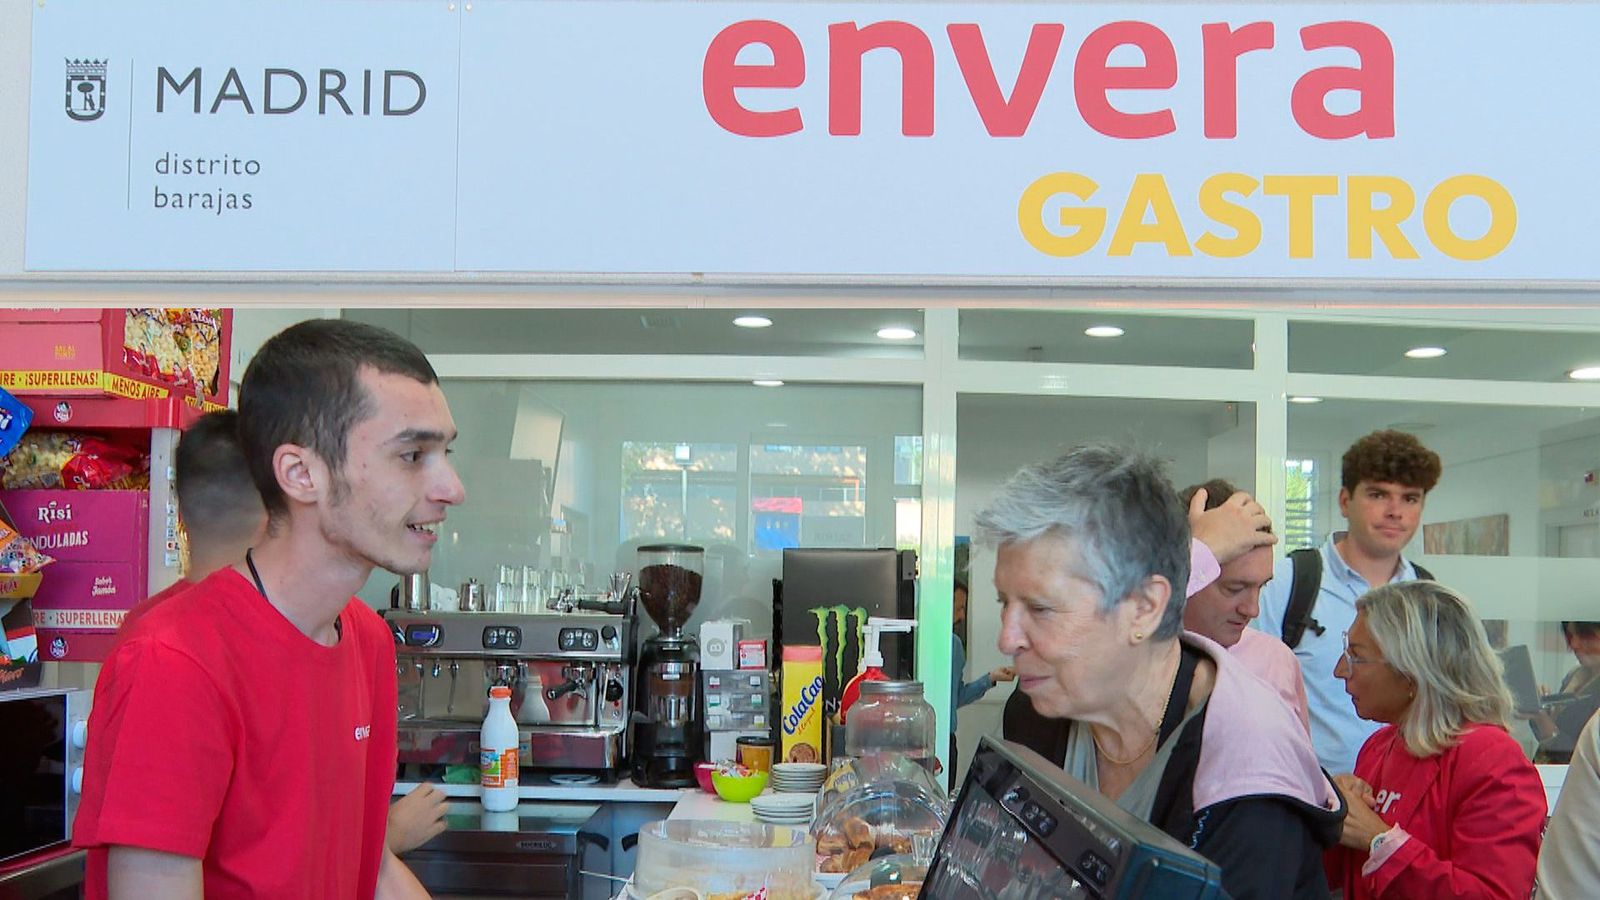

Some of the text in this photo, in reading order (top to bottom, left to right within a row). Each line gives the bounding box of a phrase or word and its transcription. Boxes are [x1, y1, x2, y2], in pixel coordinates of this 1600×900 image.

[156, 66, 426, 116] MADRID
[702, 19, 1395, 140] envera
[155, 152, 261, 175] distrito
[154, 186, 253, 215] barajas
[1017, 172, 1518, 261] GASTRO
[25, 373, 98, 386] ¡SUPERLLENAS!
[112, 377, 140, 397] MENOS
[38, 501, 71, 523] Risi
[783, 676, 824, 734] ColaCao
